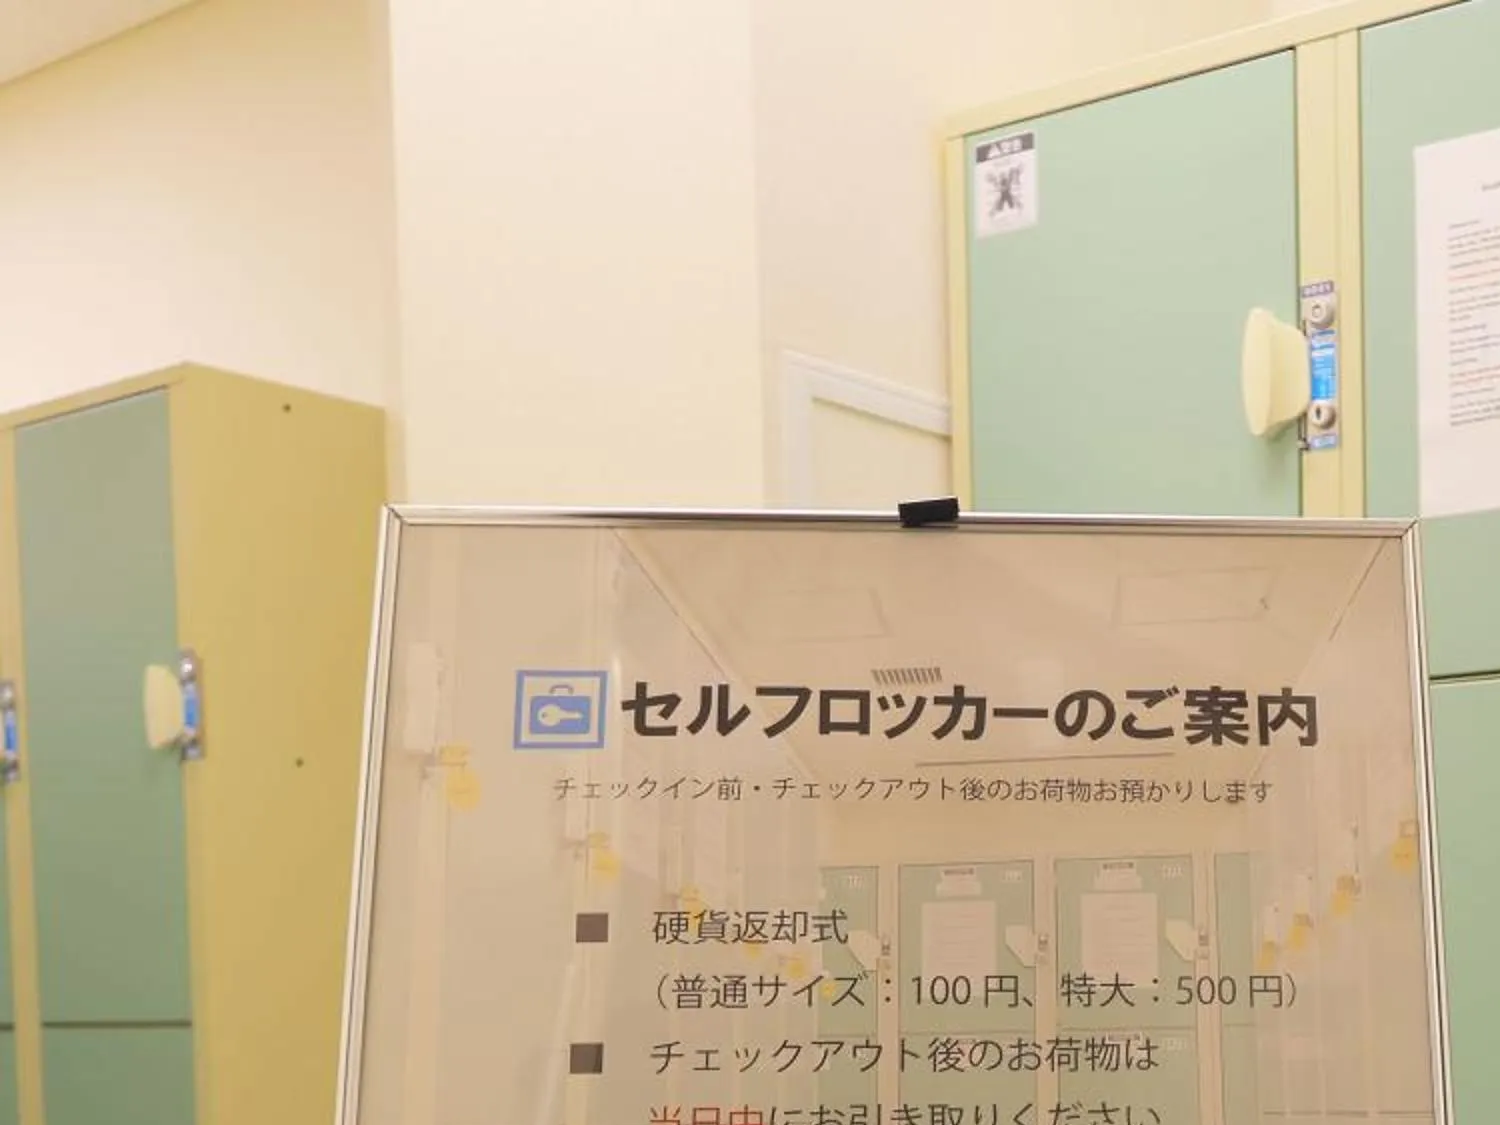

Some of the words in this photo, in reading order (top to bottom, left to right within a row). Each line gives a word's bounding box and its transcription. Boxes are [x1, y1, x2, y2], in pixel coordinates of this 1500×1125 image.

[620, 681, 1319, 748] セルフロッカーのご案内
[552, 775, 1274, 804] チェックイン前・チェックアウト後のお荷物お預かりします
[652, 909, 849, 946] 硬貨返却式
[650, 1037, 1159, 1075] チェックアウト後のお荷物は
